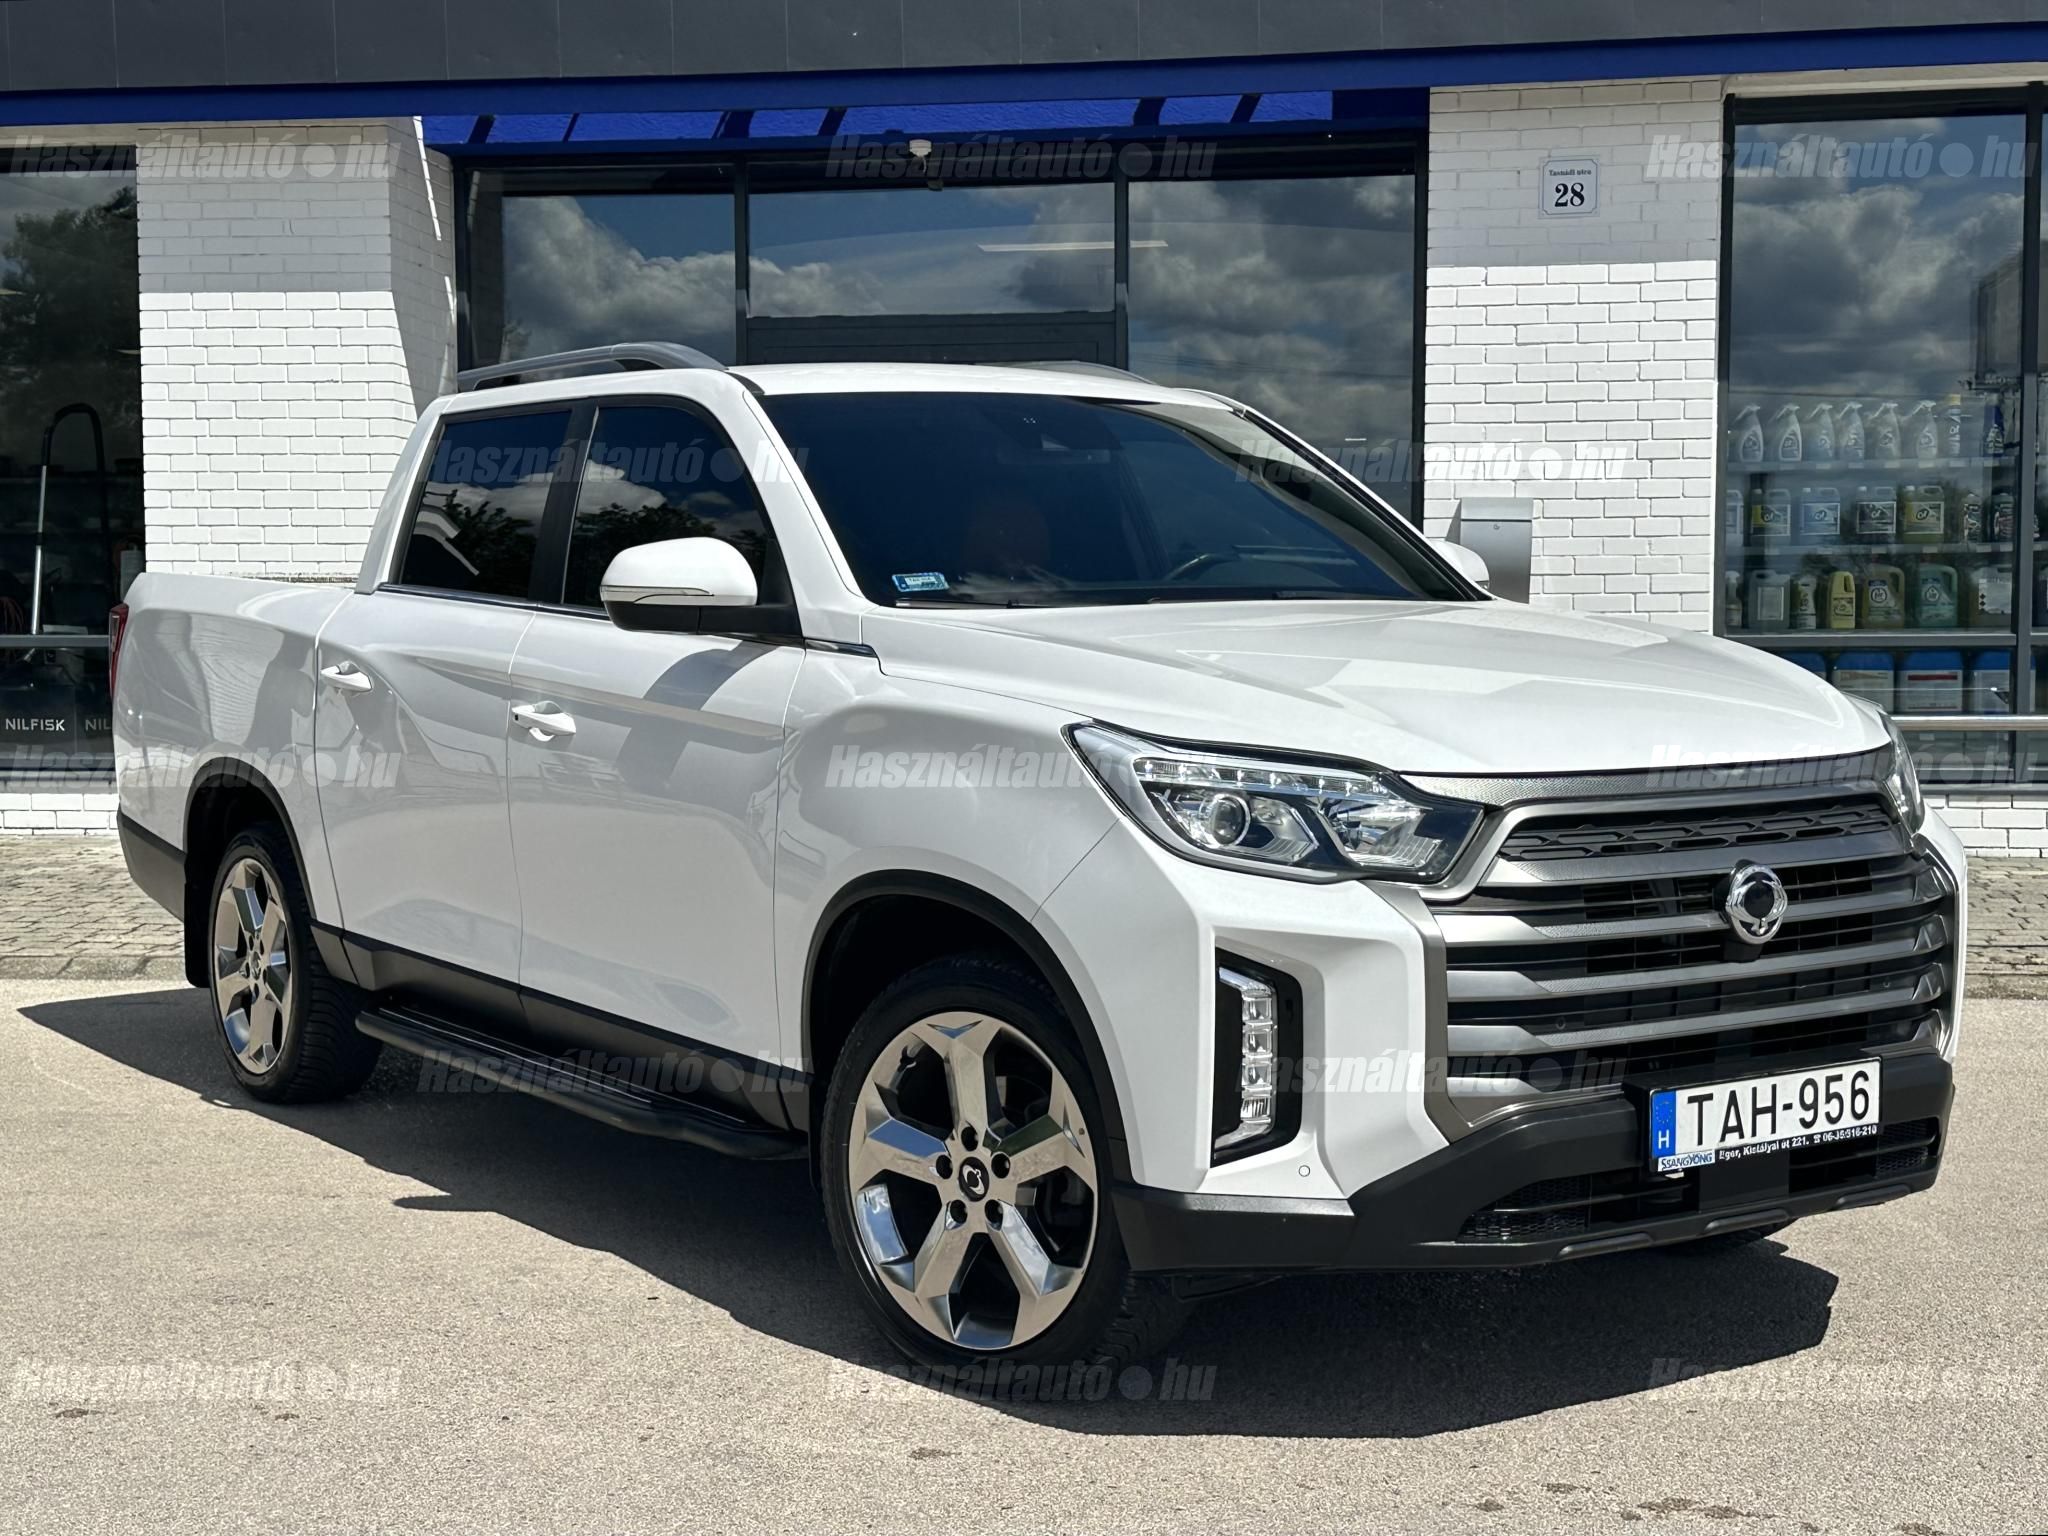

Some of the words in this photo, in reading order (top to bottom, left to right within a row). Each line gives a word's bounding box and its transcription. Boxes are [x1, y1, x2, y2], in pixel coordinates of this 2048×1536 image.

[1555, 182, 1585, 207] 28
[5, 718, 65, 731] NILFISK
[1687, 1070, 1870, 1147] TAH-956
[1658, 1129, 1670, 1150] H
[1791, 1136, 1810, 1147] 221.
